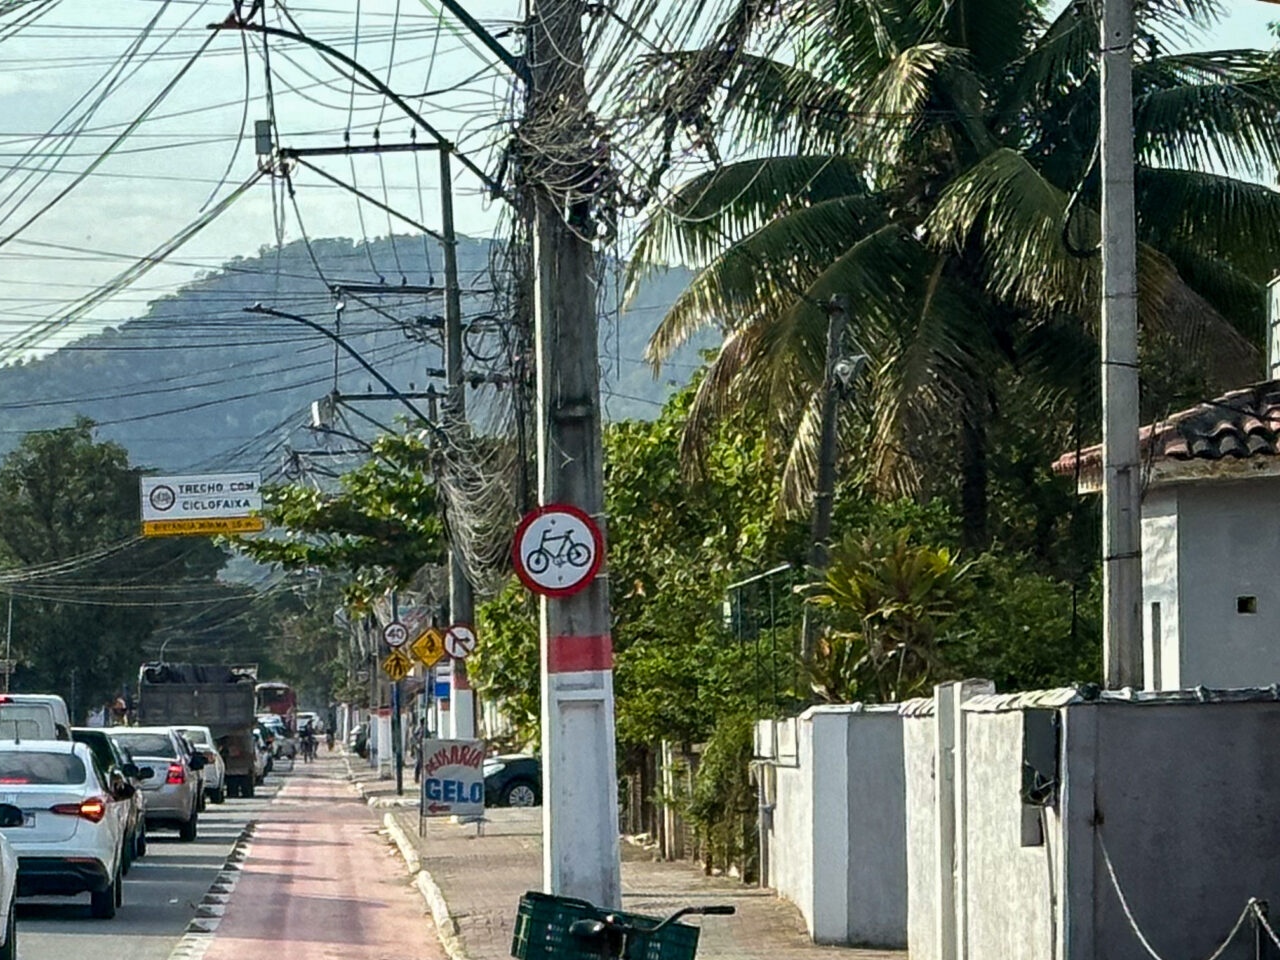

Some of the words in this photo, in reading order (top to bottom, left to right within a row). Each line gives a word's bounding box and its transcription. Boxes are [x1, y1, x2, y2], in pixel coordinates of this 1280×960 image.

[178, 482, 224, 494] TRECHO
[230, 480, 255, 492] COM
[182, 498, 251, 511] CICLOFAIXA
[387, 628, 405, 640] 40
[425, 744, 483, 777] PEIXARIA
[425, 777, 483, 804] GELO
